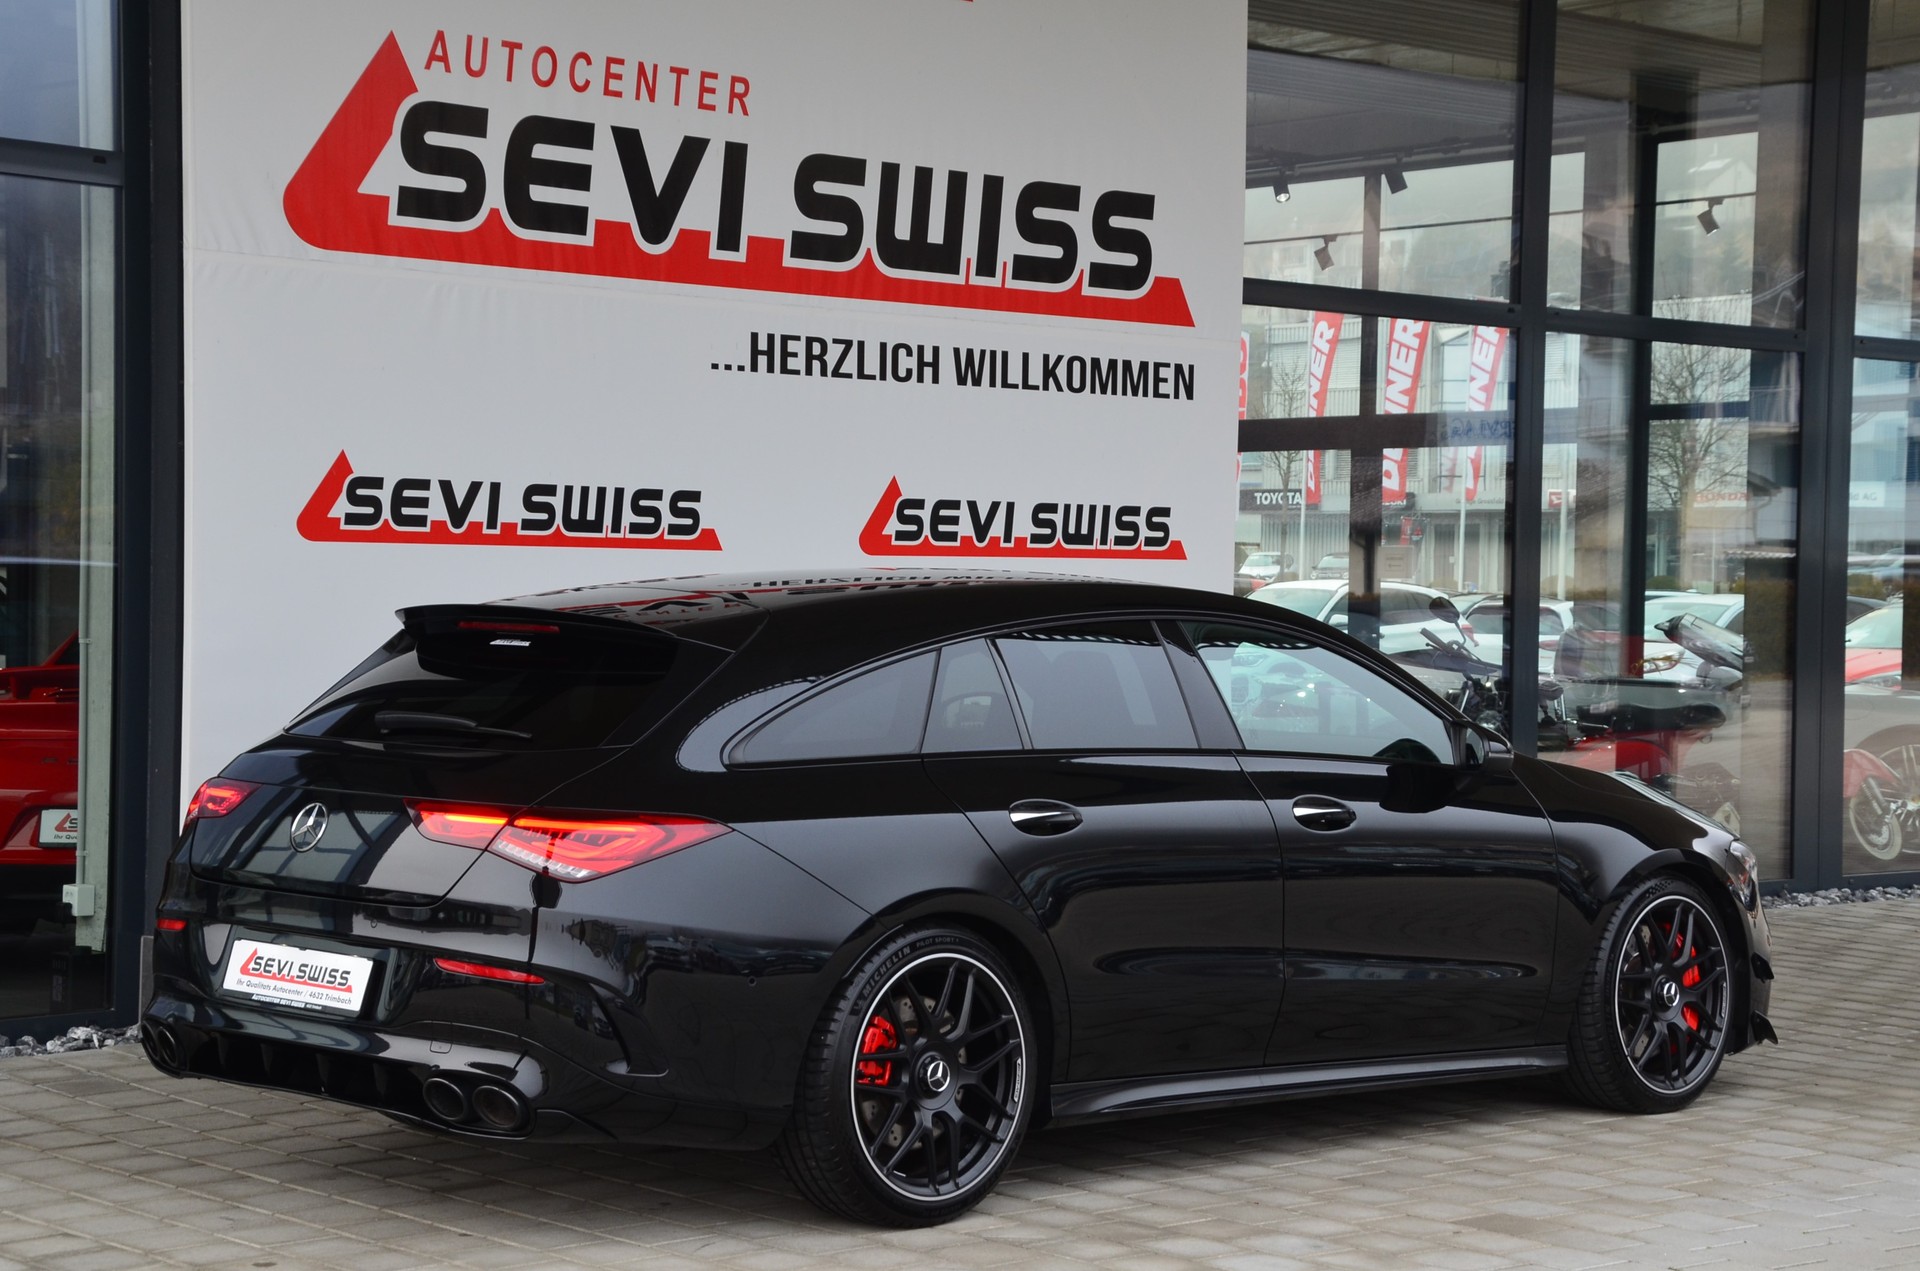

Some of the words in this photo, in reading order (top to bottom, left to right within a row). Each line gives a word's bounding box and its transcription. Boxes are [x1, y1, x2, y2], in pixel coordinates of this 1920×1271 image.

[425, 31, 750, 115] AUTOCENTER
[397, 101, 748, 252] SEVI
[790, 154, 1155, 290] SWISS
[953, 347, 1194, 400] WILLKOMMEN
[1308, 320, 1334, 492] DNER
[1383, 319, 1424, 490] DNER
[344, 477, 500, 529] SEVI
[521, 484, 701, 535] SWISS
[895, 499, 1014, 543] SEVI
[1030, 503, 1170, 547] SWISS
[252, 956, 293, 976] SEVI
[296, 963, 350, 986] SWISS
[272, 984, 303, 997] Autocenter
[309, 991, 324, 1000] 4632
[325, 993, 352, 1005] Trimbach
[862, 945, 911, 997] MICHELIN
